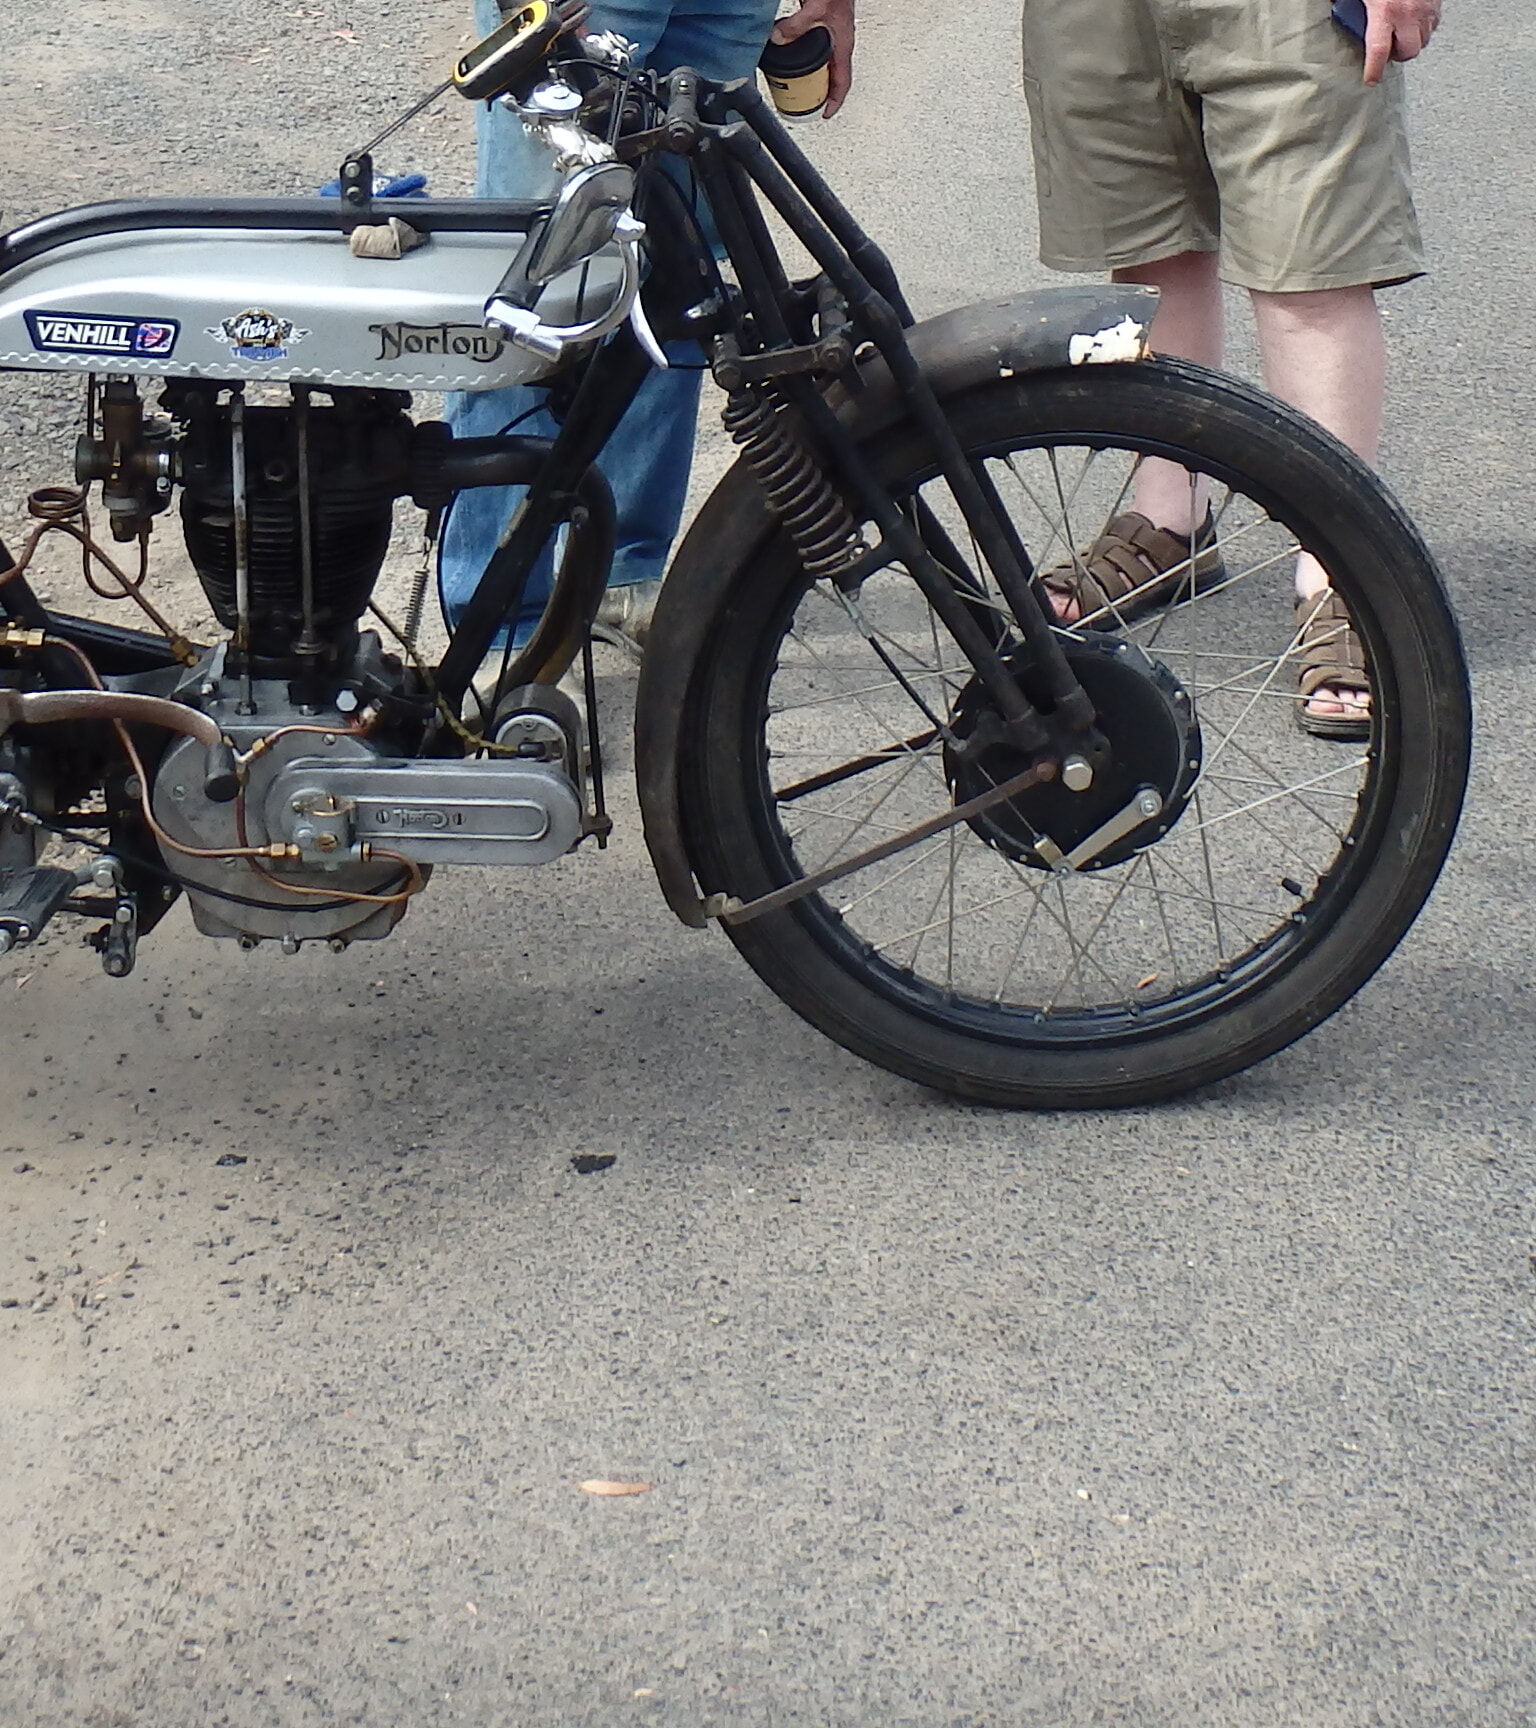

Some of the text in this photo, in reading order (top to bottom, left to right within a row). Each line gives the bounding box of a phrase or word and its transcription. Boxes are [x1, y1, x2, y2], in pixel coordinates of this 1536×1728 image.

[36, 321, 132, 347] VENHILL
[235, 317, 279, 340] Ash's
[368, 321, 505, 363] Norton
